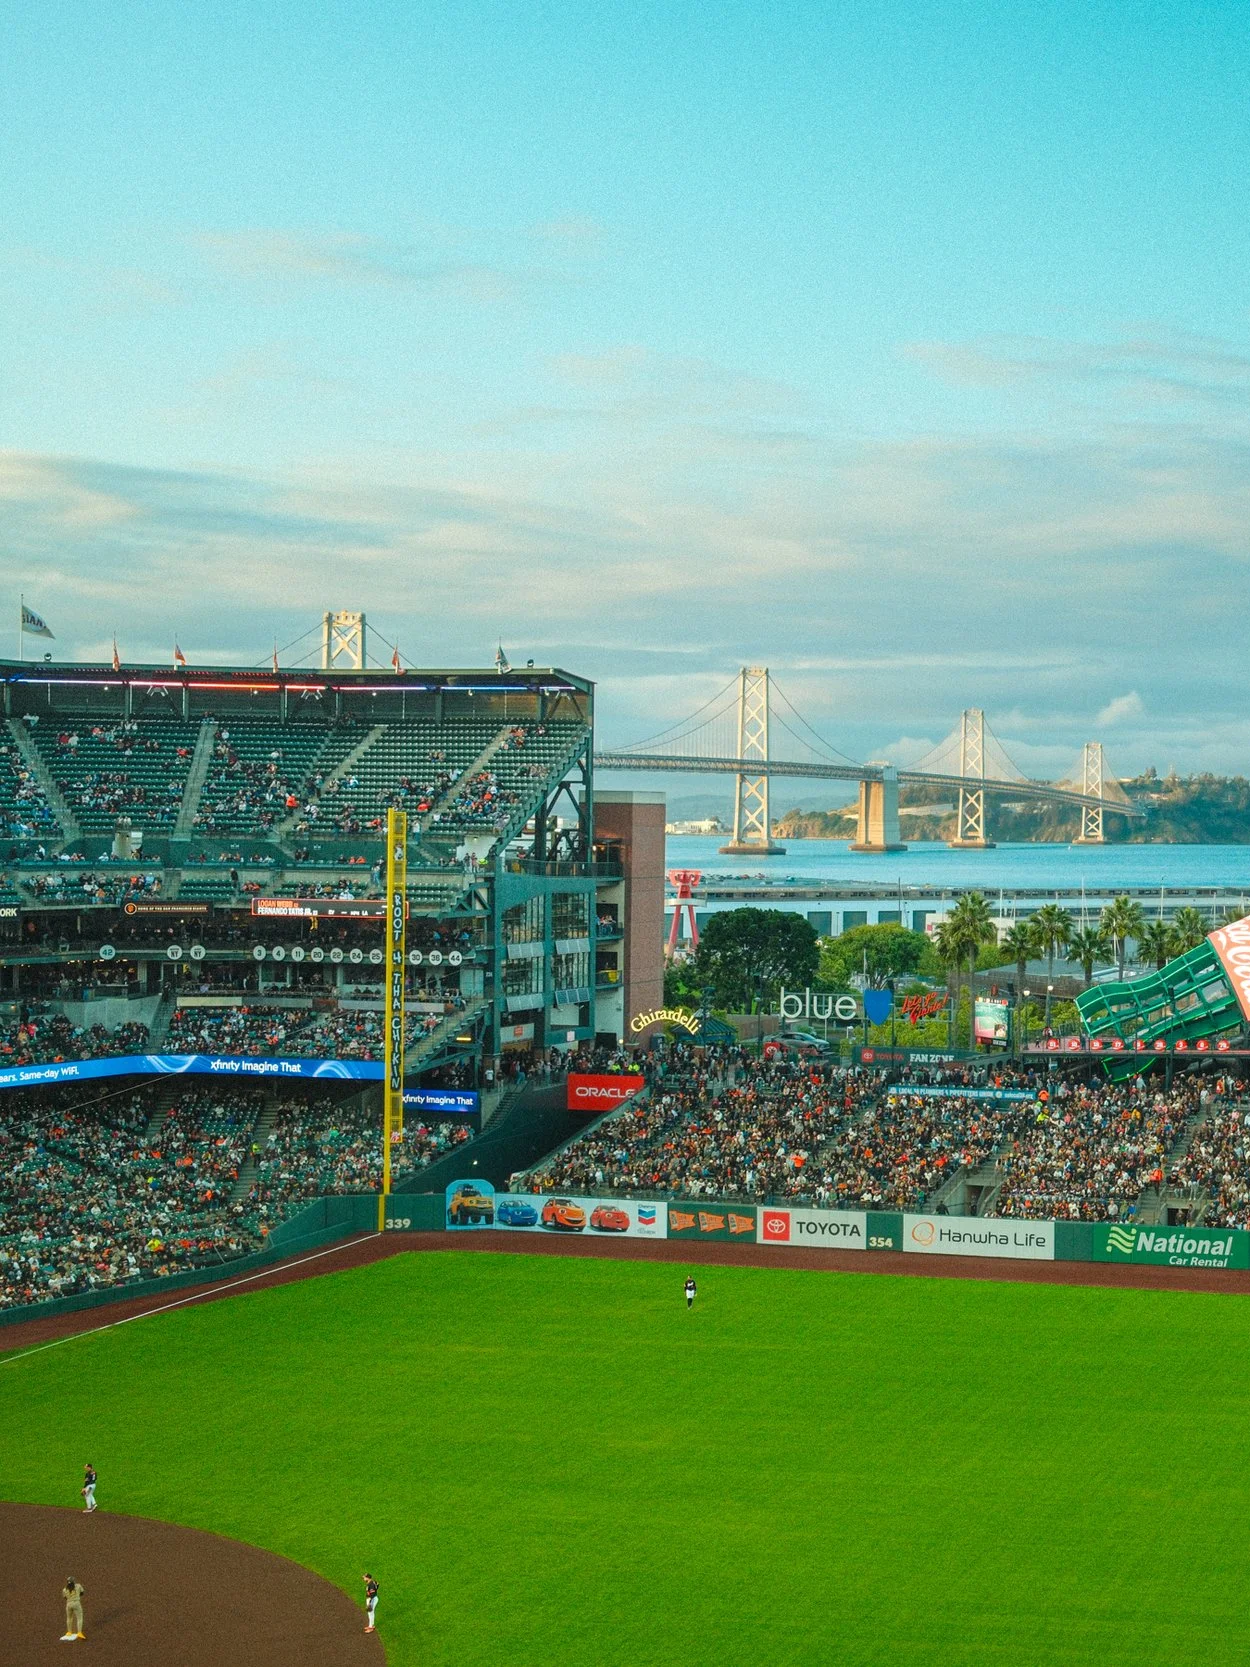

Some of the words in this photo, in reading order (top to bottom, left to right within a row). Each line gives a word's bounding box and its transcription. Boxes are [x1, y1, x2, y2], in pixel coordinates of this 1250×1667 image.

[393, 894, 402, 940] ROOT
[102, 948, 113, 956] 42
[392, 973, 401, 1010] THA
[780, 986, 857, 1020] blue
[630, 1008, 702, 1035] Ghirardelli
[392, 1018, 401, 1088] CHIKIN
[910, 1054, 928, 1063] FAN
[210, 1060, 240, 1071] xfinity
[242, 1061, 278, 1072] Imagine
[280, 1062, 302, 1073] That
[20, 1070, 60, 1082] Same-day
[576, 1086, 637, 1098] ORACLE
[426, 1096, 456, 1106] Imagine
[456, 1096, 474, 1106] That
[386, 1218, 410, 1230] 339
[796, 1221, 861, 1237] TOYOTA
[869, 1236, 893, 1248] 354
[940, 1228, 1009, 1246] Hanwha
[1014, 1232, 1046, 1248] Life
[1136, 1232, 1233, 1256] National
[1168, 1255, 1189, 1266] Car
[1190, 1257, 1228, 1268] Rental
